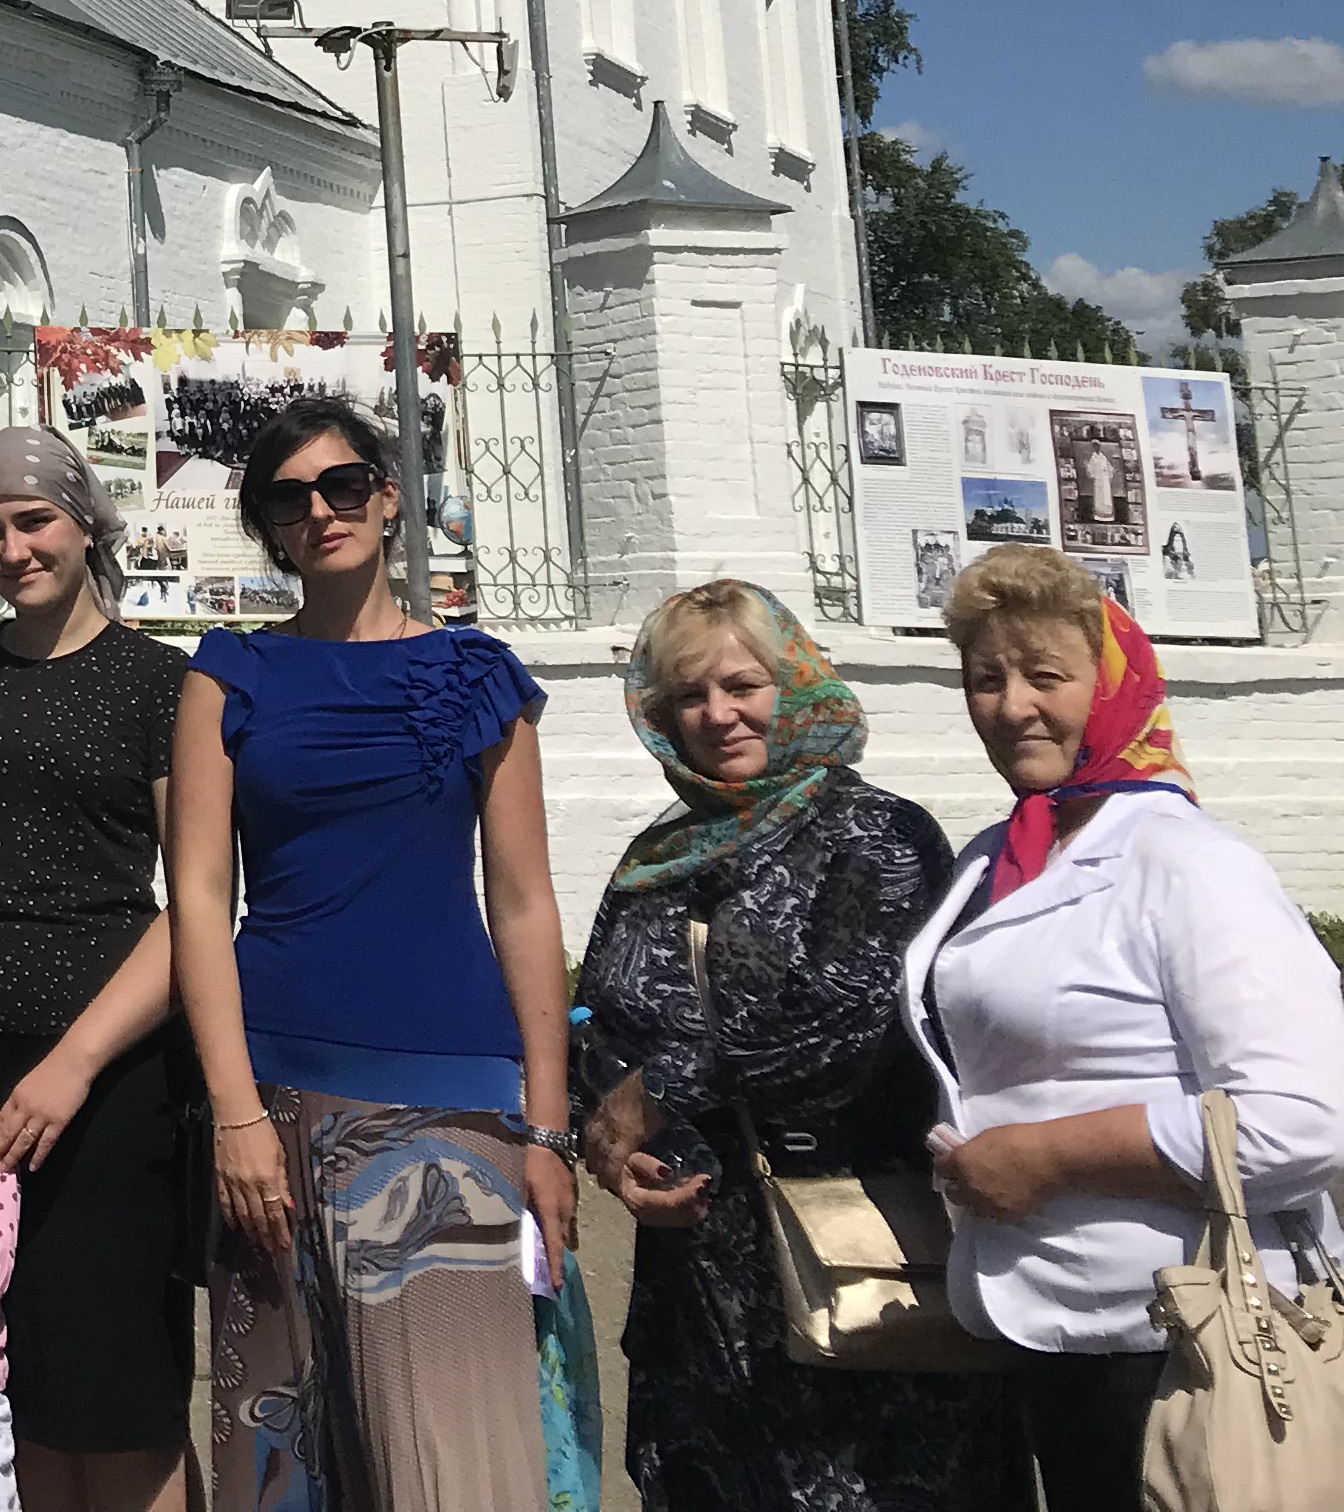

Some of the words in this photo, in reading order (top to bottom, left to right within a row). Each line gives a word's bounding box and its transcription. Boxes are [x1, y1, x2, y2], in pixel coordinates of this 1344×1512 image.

[880, 356, 979, 380] Годеновский
[981, 363, 1026, 386] Крест
[1029, 366, 1106, 390] Господень
[149, 490, 217, 513] Нашей
